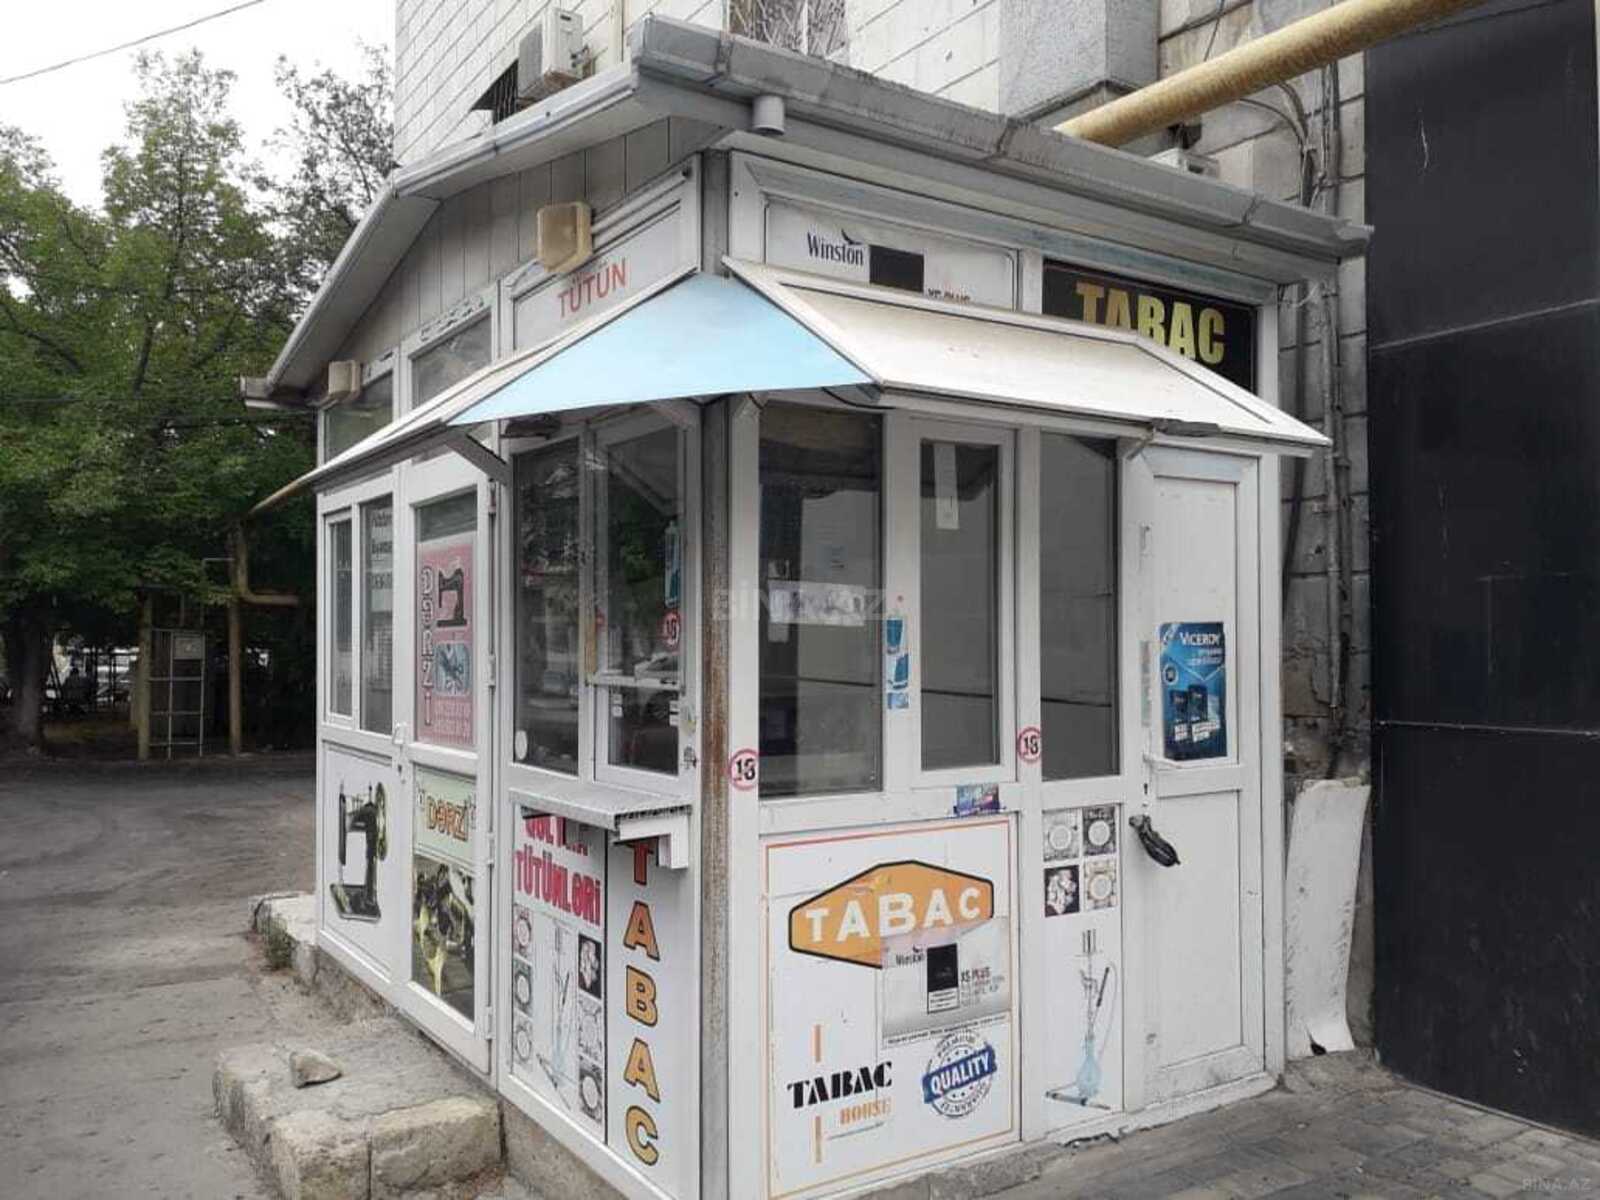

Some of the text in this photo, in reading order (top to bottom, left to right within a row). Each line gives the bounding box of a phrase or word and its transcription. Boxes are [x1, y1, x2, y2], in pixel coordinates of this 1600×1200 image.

[807, 232, 864, 266] Winston
[558, 257, 626, 318] TÜTÜN
[1076, 281, 1225, 364] TABAC
[805, 886, 982, 944] TABAC
[623, 838, 661, 1167] TABAC
[787, 1060, 893, 1110] TABAC
[930, 1051, 990, 1097] QUALITY
